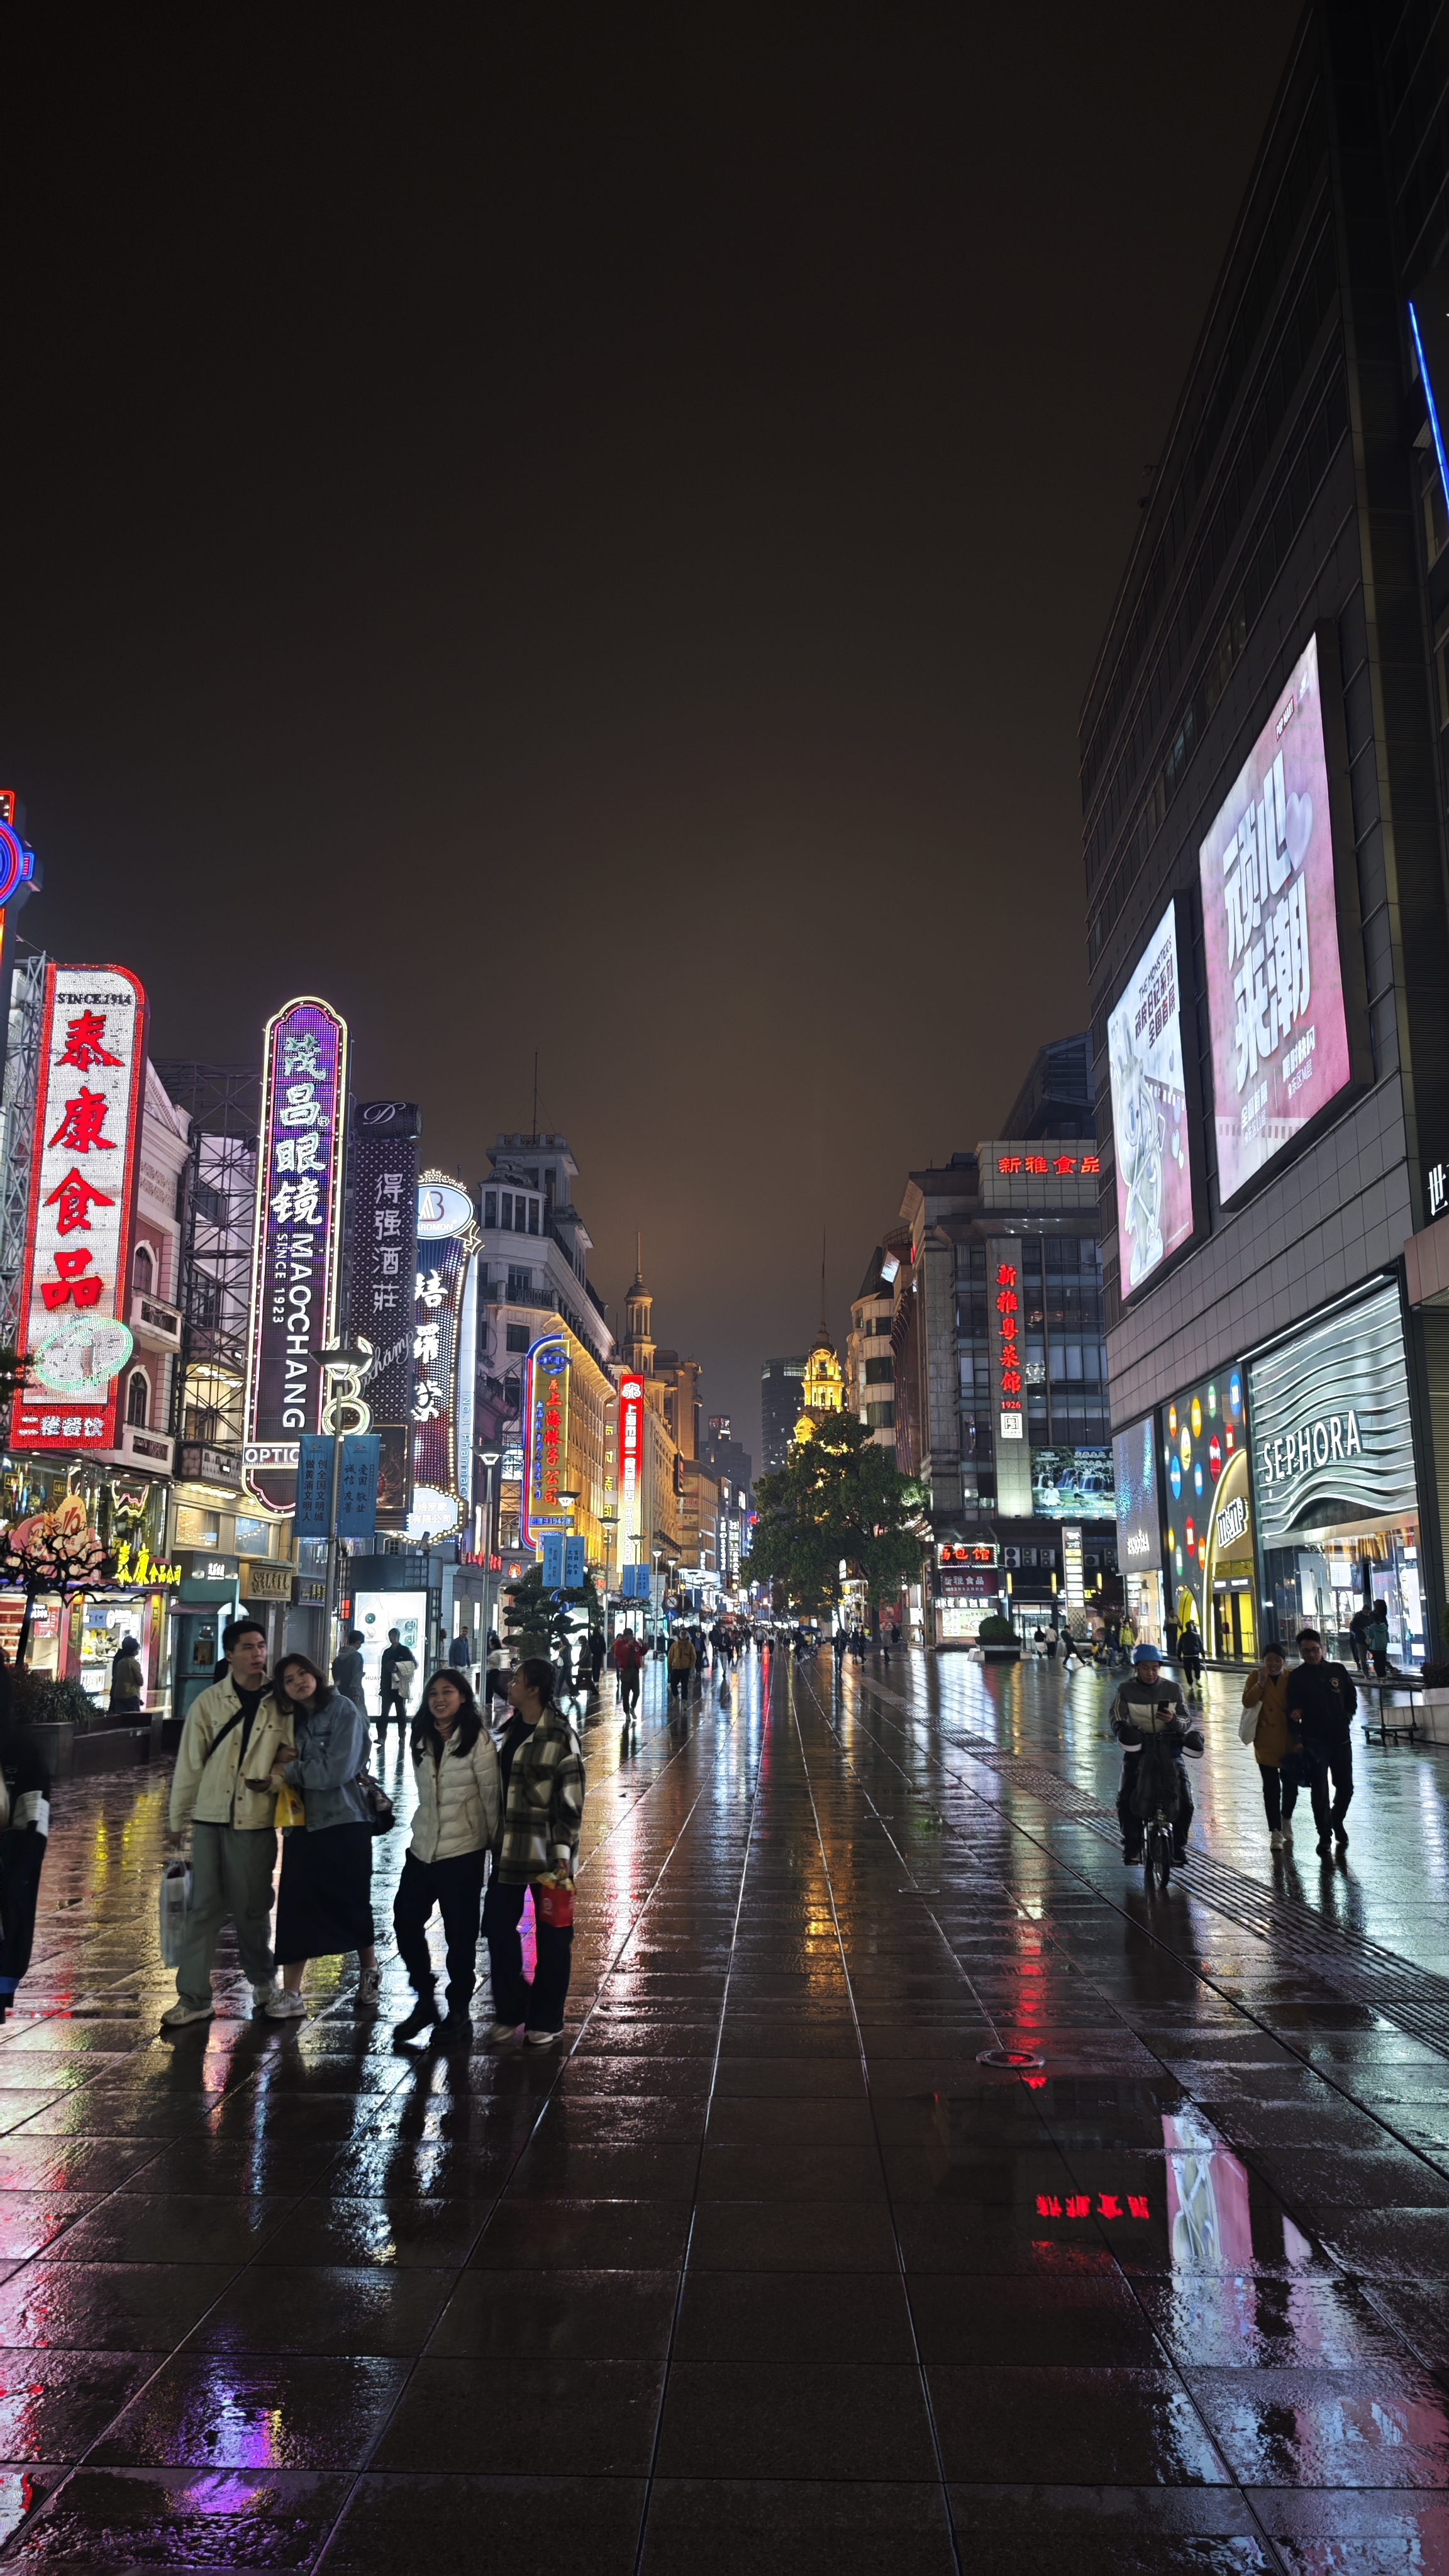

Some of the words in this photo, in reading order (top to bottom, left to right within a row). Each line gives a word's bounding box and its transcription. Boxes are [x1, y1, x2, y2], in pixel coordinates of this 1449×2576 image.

[58, 993, 101, 1004] SINCE
[101, 992, 131, 1005] 1914
[1235, 871, 1311, 1094] 来潮
[1148, 983, 1175, 1050] 全国首展
[270, 1033, 326, 1225] 茂昌眼镜
[1241, 1080, 1268, 1130] 全国首展
[41, 1009, 125, 1310] 泰康食品
[997, 1155, 1101, 1175] 新雅食品
[275, 1233, 288, 1279] SINCE
[272, 1287, 286, 1323] 1923
[283, 1233, 314, 1428] MAOCHANG
[997, 1263, 1021, 1394] 新雅粤菜馆
[18, 1416, 104, 1437] 二楼餐饮
[461, 1394, 472, 1426] No.1
[1001, 1401, 1021, 1409] 1926
[1263, 1409, 1361, 1482] SEPHORA
[302, 1459, 315, 1522] 做黄浦文明人
[314, 1459, 328, 1521] 创全国文明城
